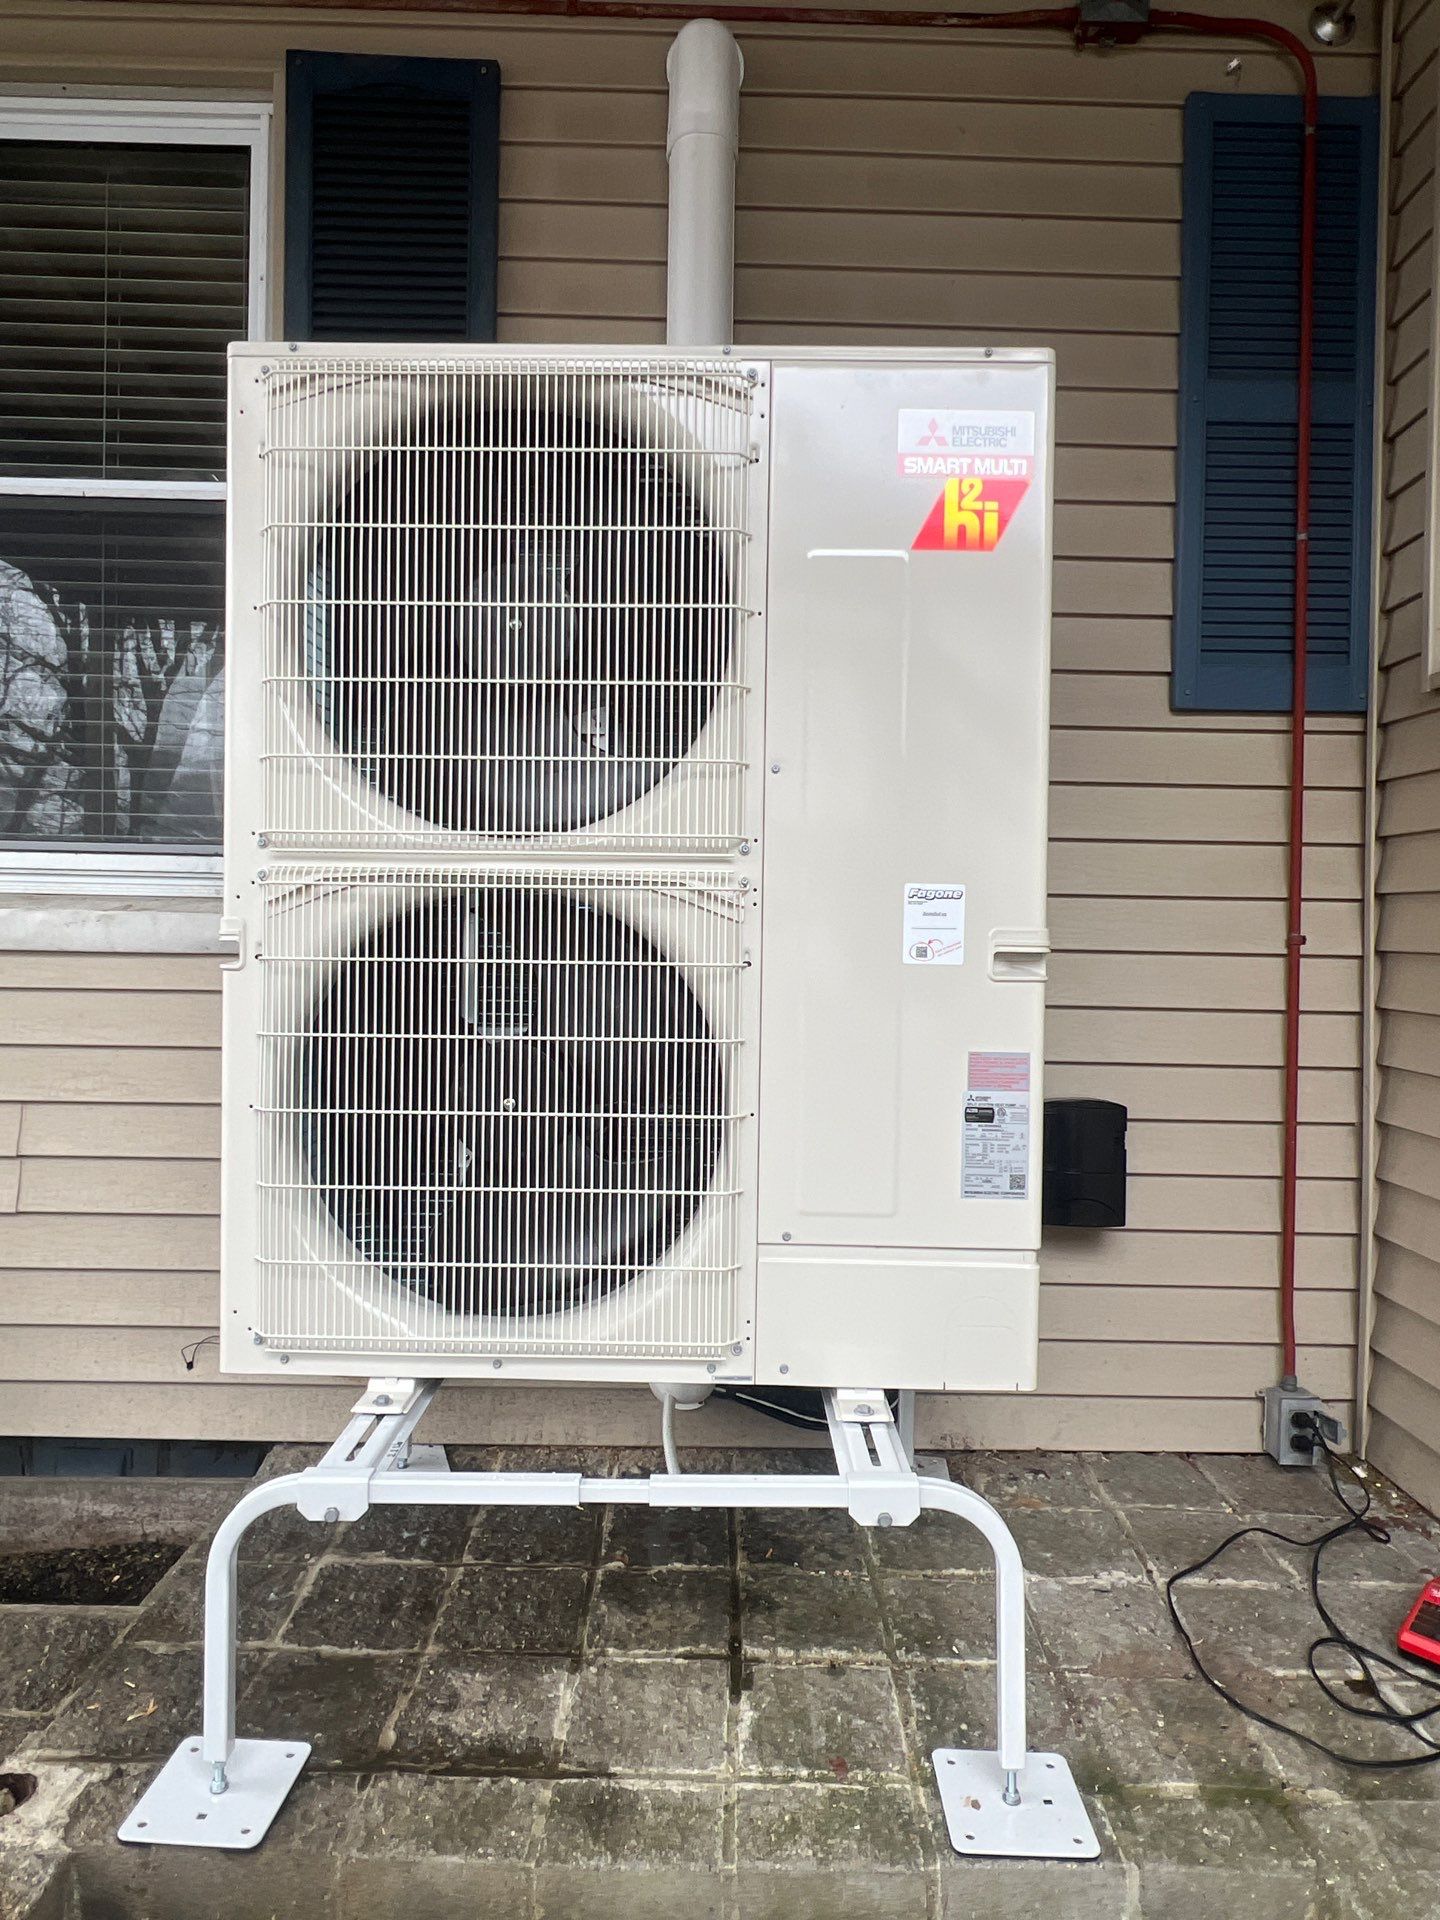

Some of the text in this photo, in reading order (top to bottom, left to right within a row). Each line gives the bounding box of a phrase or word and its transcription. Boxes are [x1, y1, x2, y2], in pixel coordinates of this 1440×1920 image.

[952, 426, 1017, 437] MITSUBISHI
[952, 437, 1008, 448] ELECTRIC
[904, 457, 1028, 476] SMART MULTI
[908, 888, 963, 900] Fagone
